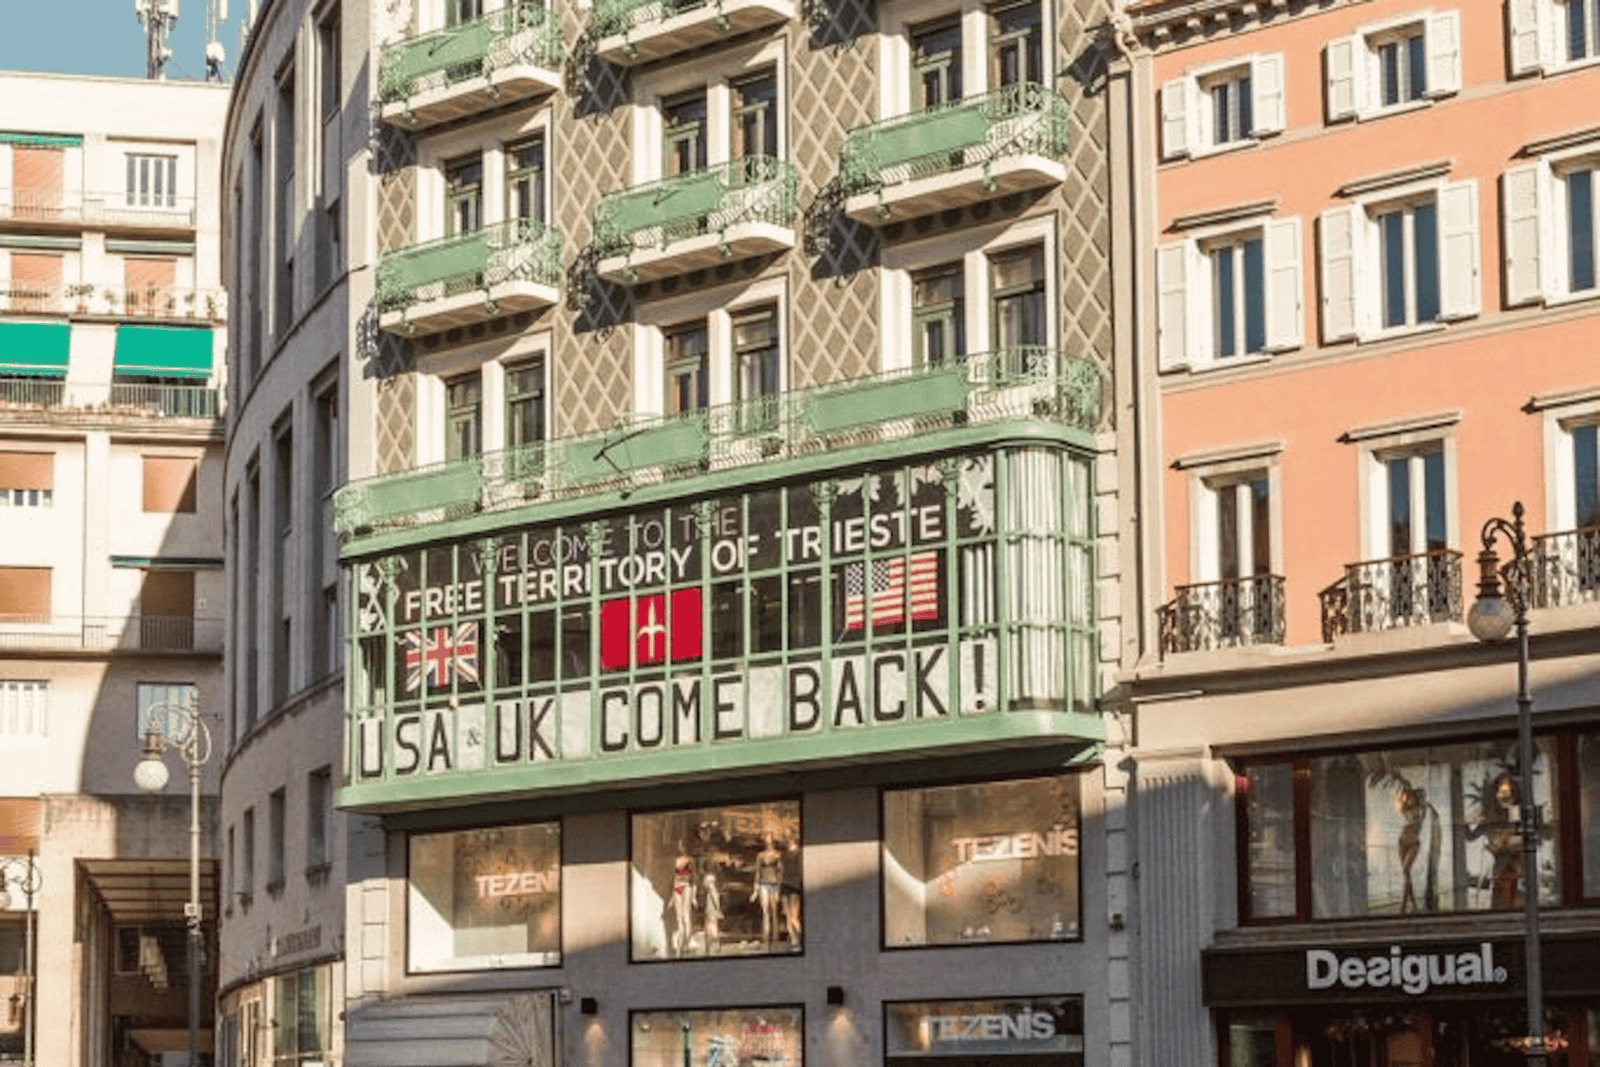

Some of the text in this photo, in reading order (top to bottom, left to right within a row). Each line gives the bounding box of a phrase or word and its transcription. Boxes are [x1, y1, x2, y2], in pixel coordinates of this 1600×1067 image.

[621, 519, 664, 549] TO
[678, 506, 738, 542] THE
[405, 505, 943, 621] FREE TERRITORY OF TRIESTE
[360, 711, 452, 778] USA
[496, 698, 557, 763] UK
[601, 675, 743, 752] COME
[951, 823, 1078, 861] TEZENIS
[922, 1006, 1056, 1041] TEZENIS
